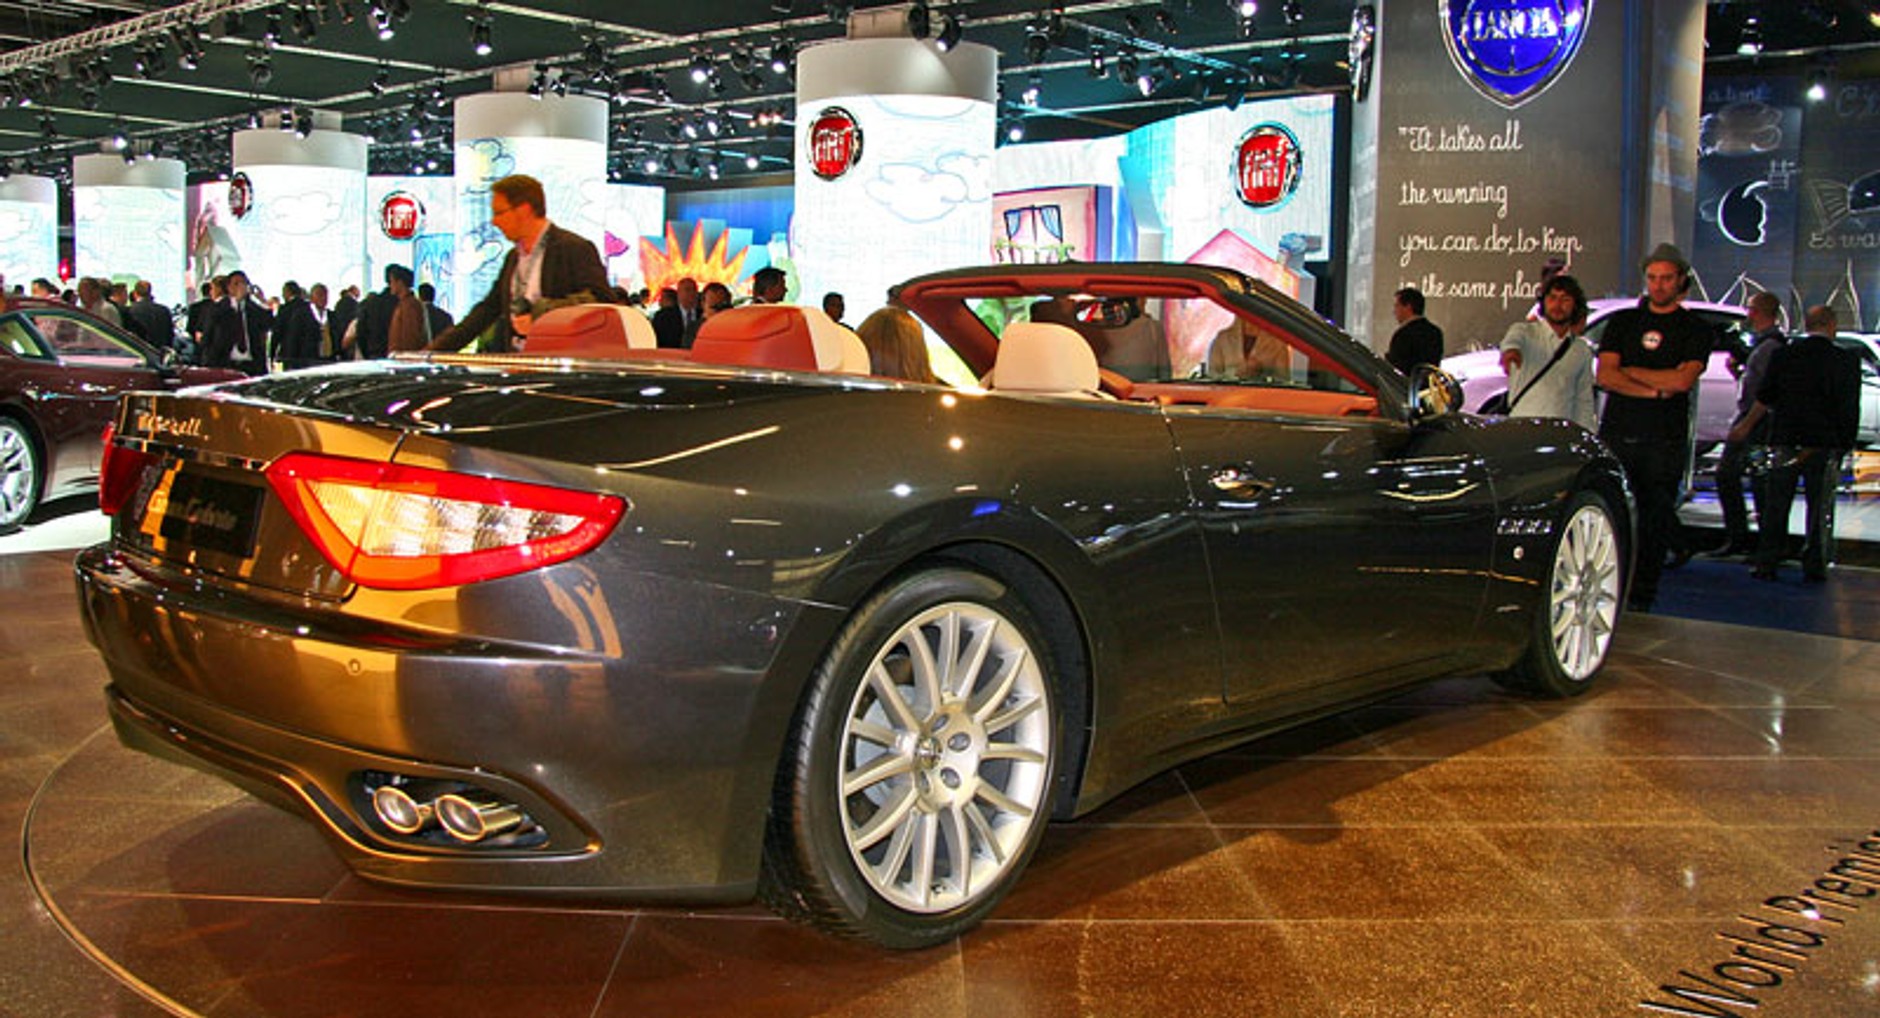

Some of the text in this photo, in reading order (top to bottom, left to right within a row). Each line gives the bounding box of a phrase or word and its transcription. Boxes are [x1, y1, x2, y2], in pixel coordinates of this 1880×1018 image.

[815, 127, 853, 162] FIAT
[1436, 124, 1486, 151] takes
[1488, 119, 1524, 151] all
[1243, 143, 1284, 189] FIAT
[387, 204, 416, 230] FIAT
[1399, 181, 1508, 219] the running
[1399, 234, 1440, 268] you
[1440, 234, 1482, 251] can
[1421, 272, 1445, 298] the
[1446, 281, 1497, 298] same
[1500, 270, 1543, 309] plac
[1638, 914, 1829, 1018] World
